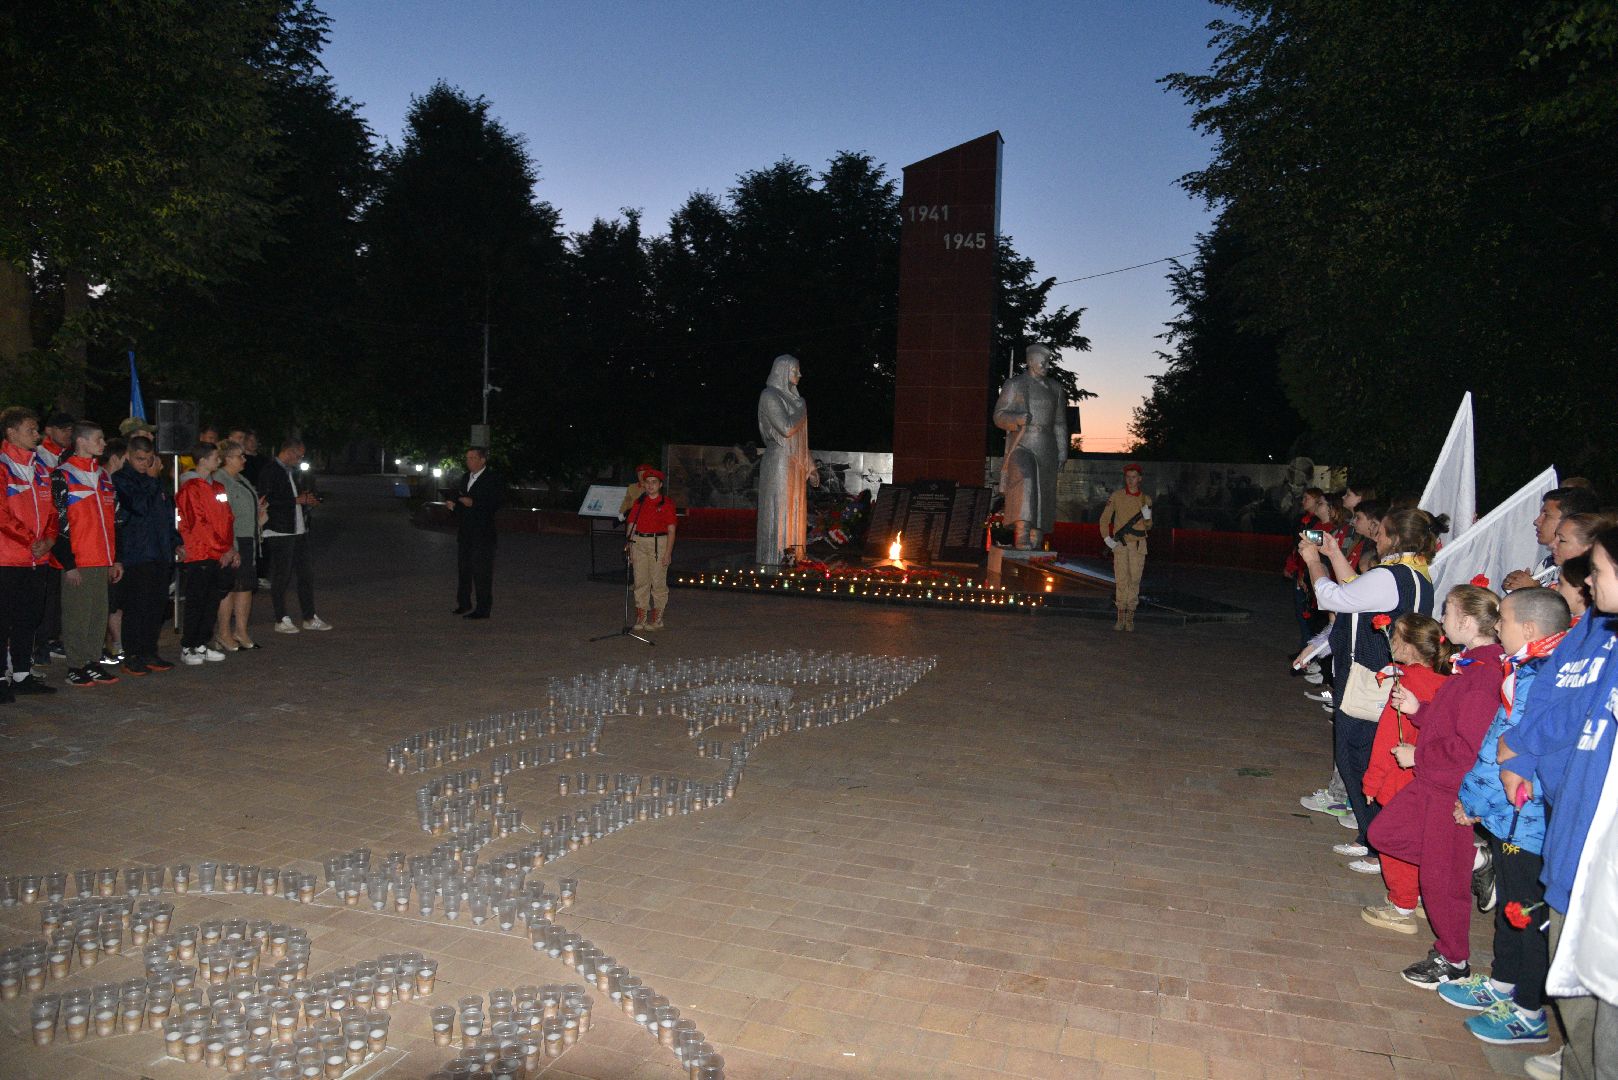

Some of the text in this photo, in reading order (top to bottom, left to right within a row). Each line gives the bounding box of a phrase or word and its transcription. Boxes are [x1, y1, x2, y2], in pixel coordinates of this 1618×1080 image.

[908, 204, 949, 222] 1941
[943, 232, 986, 250] 1945
[1471, 988, 1494, 1004] N
[1505, 1020, 1528, 1038] N
